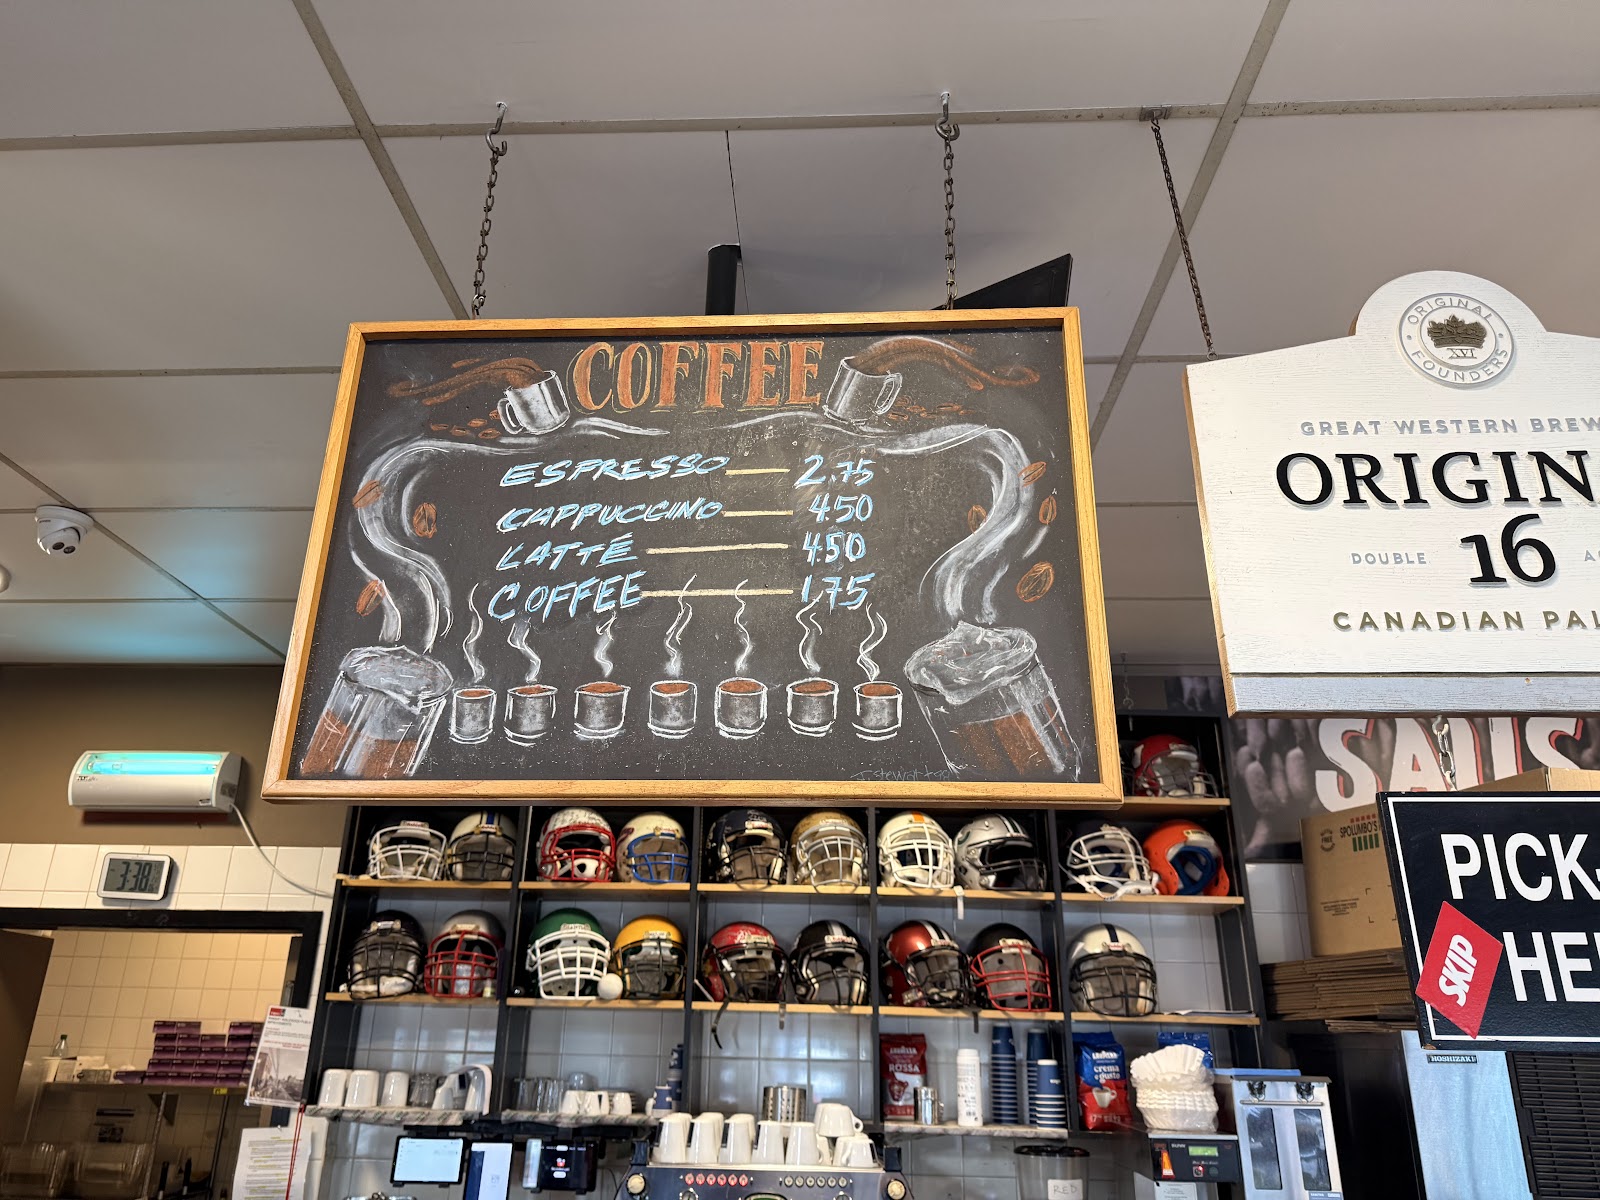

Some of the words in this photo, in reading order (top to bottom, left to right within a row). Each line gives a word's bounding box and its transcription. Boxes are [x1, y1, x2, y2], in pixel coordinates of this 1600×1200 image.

[1407, 297, 1493, 325] ORIGINAL
[1412, 348, 1508, 381] FOUNDERS
[1446, 347, 1477, 359] XVI
[568, 340, 824, 412] COFFEE
[1300, 420, 1381, 436] GREAT
[1394, 418, 1518, 434] WESTERN
[1529, 416, 1600, 433] BREW
[499, 452, 730, 488] ESPRESSO
[1276, 450, 1596, 506] ORIGIN
[496, 496, 723, 533] CAPPUCCINO
[495, 532, 639, 571] LATTÉ
[1351, 552, 1427, 565] DOUBLE
[1460, 513, 1557, 585] 16
[1584, 549, 1600, 562] A
[488, 570, 647, 623] COFFEE
[1333, 611, 1525, 631] CANADIAN
[1340, 820, 1378, 838] SPOLUMBO'S
[116, 861, 153, 892] 3:38
[1438, 934, 1478, 1007] SKIP
[1502, 931, 1600, 1002] HE
[888, 1063, 920, 1073] ROSSA
[1093, 1065, 1120, 1073] crema
[1430, 1055, 1477, 1063] HOSHIZAKI
[1053, 1184, 1078, 1195] RED
